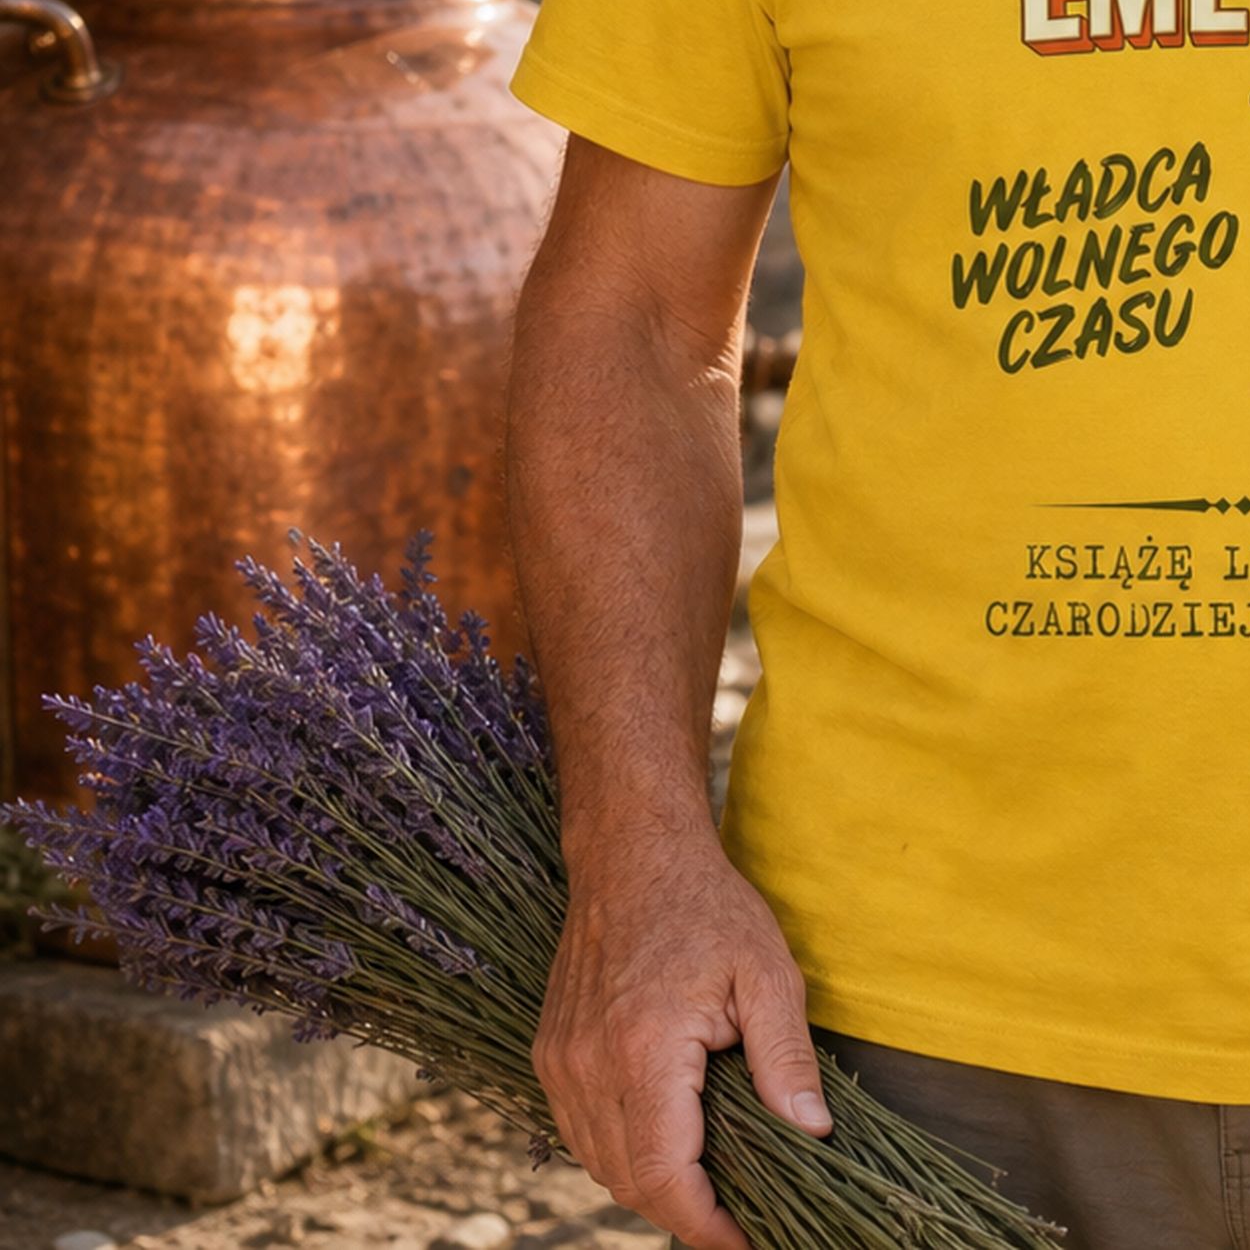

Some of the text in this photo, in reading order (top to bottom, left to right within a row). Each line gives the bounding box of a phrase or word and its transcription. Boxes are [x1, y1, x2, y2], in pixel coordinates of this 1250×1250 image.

[969, 141, 1211, 236] WŁADCA
[951, 211, 1239, 309] WOLNEGO
[999, 288, 1194, 374] CZASU
[1025, 535, 1193, 590] KSIĄŻĘ
